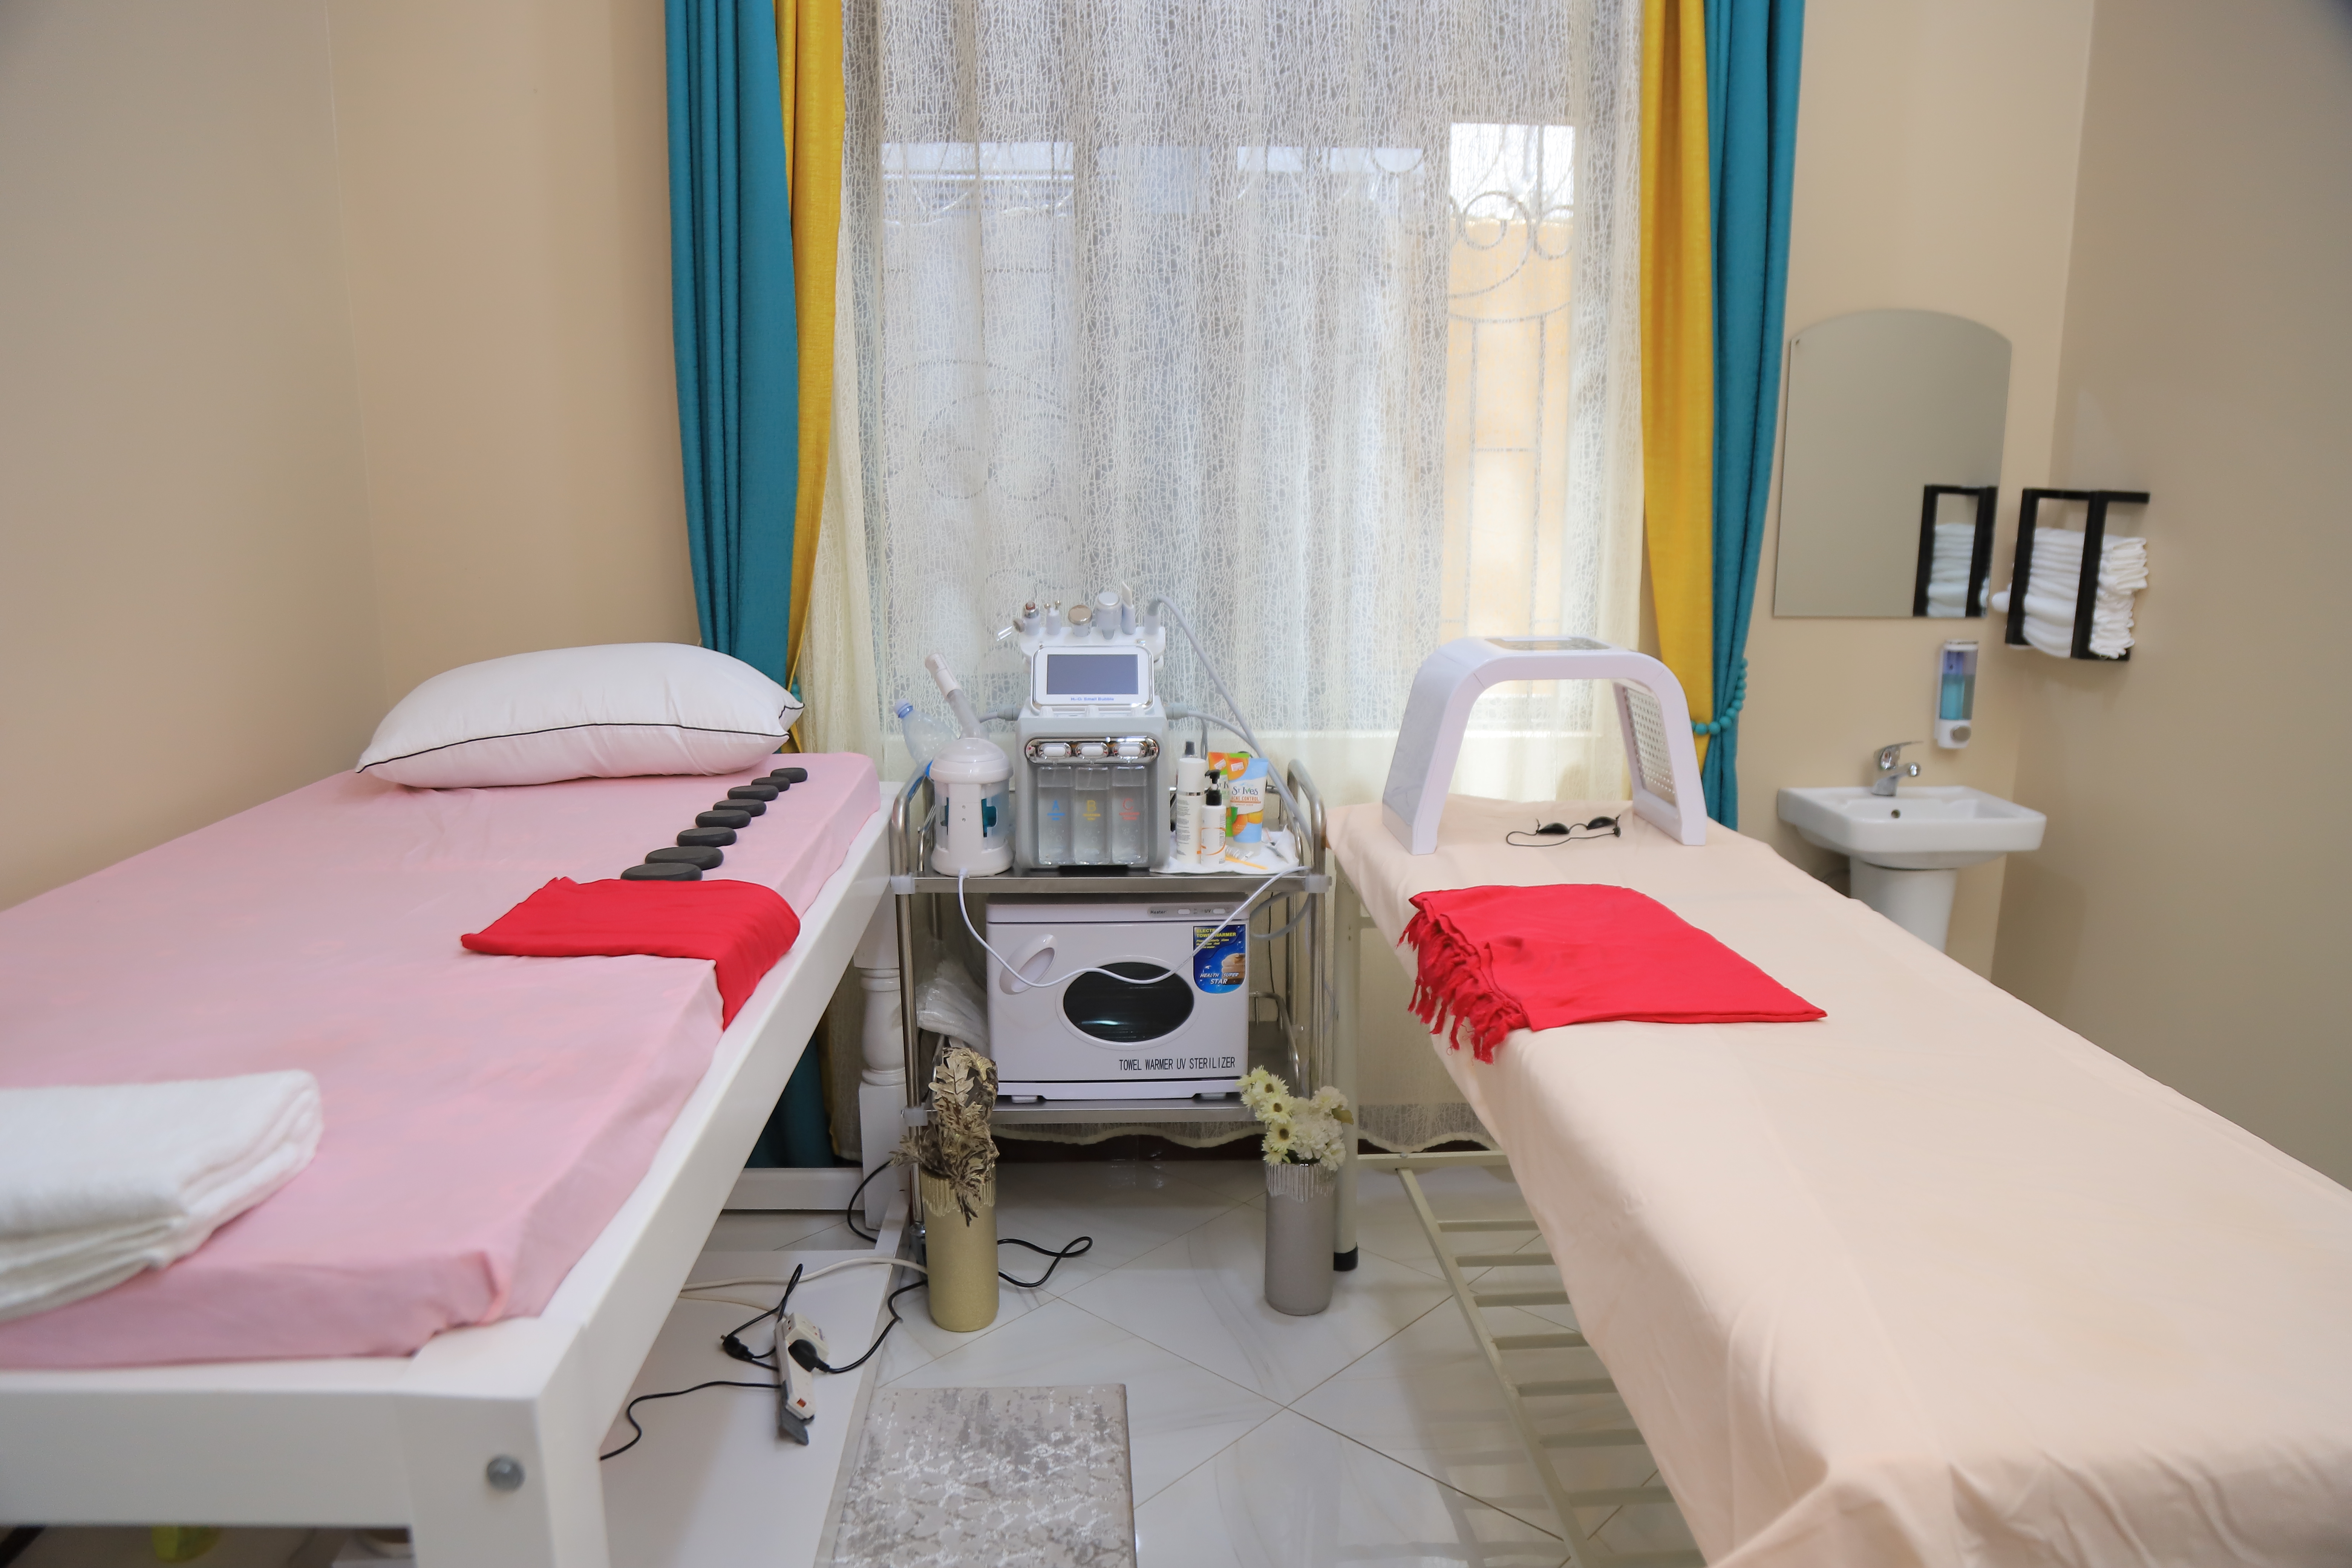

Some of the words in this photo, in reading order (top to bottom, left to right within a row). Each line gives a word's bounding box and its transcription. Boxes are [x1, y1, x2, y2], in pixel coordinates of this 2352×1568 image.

[1052, 800, 1060, 811] A
[1087, 800, 1096, 811] B
[1122, 798, 1133, 810] C
[1119, 1060, 1142, 1070] TOWEL
[1145, 1058, 1173, 1070] WARMER
[1177, 1058, 1186, 1069] UV
[1190, 1057, 1236, 1069] STERILIZER
